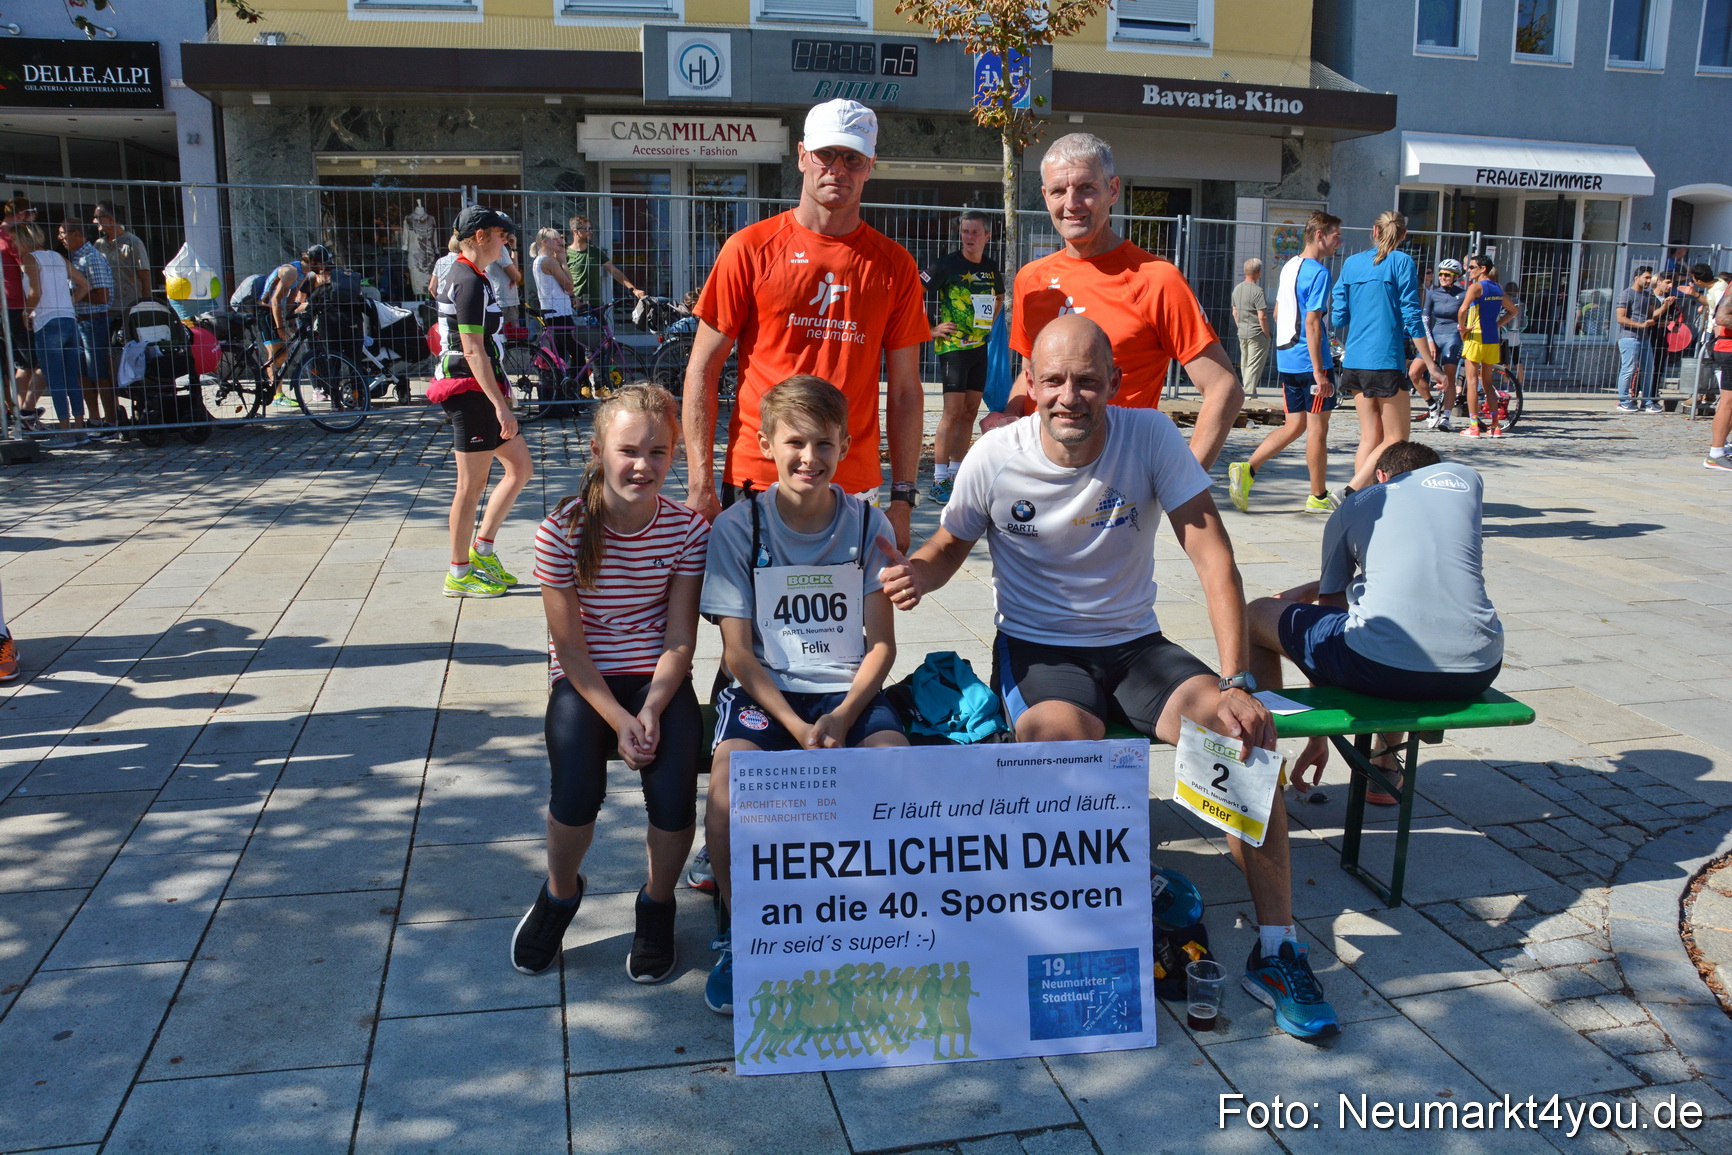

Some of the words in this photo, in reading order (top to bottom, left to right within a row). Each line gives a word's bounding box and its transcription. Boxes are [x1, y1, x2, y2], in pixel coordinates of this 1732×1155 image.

[22, 64, 151, 85] DELLE.ALPI
[68, 85, 115, 93] CAFFETTERIA
[1142, 84, 1304, 115] Bavaria-Kino
[632, 144, 690, 156] Accessoires
[700, 145, 738, 156] Fashion
[1475, 168, 1603, 191] FRAUENZIMMER
[982, 304, 993, 315] 29
[786, 313, 857, 331] funrunners
[806, 328, 866, 344] neumarkt
[1007, 523, 1038, 533] PARTL
[787, 574, 833, 587] BOCK
[773, 592, 848, 625] 4006
[782, 629, 805, 637] PARTL
[806, 627, 836, 635] Neumarkt
[801, 640, 831, 655] Felix
[996, 754, 1103, 768] funrunners-neumarkt
[739, 766, 837, 777] BERSCHNEIDER
[1210, 763, 1230, 793] 2
[739, 780, 837, 791] BERSCHNEIDER
[1191, 781, 1210, 796] PARTL
[1210, 791, 1240, 809] Neumarkt
[740, 799, 807, 809] ARCHITEKTEN
[817, 798, 837, 807] BDA
[873, 803, 896, 820] Er
[900, 800, 942, 819] läuft
[948, 800, 984, 817] und
[989, 797, 1030, 815] läuft
[1036, 796, 1070, 813] und
[1076, 794, 1132, 811] läuft...
[1202, 799, 1232, 822] Peter
[740, 812, 837, 824] INNENARCHITEKTEN
[752, 833, 1009, 881] HERZLICHEN
[1022, 827, 1131, 869] DANK
[761, 902, 802, 925] an
[816, 895, 868, 923] die
[879, 892, 928, 919] 40.
[940, 886, 1123, 922] Sponsoren
[750, 938, 778, 955] Ihr
[848, 931, 909, 953] super!
[1041, 957, 1071, 977] 19.
[1042, 977, 1107, 989] Neumarkter
[1042, 990, 1095, 1003] Stadtlauf
